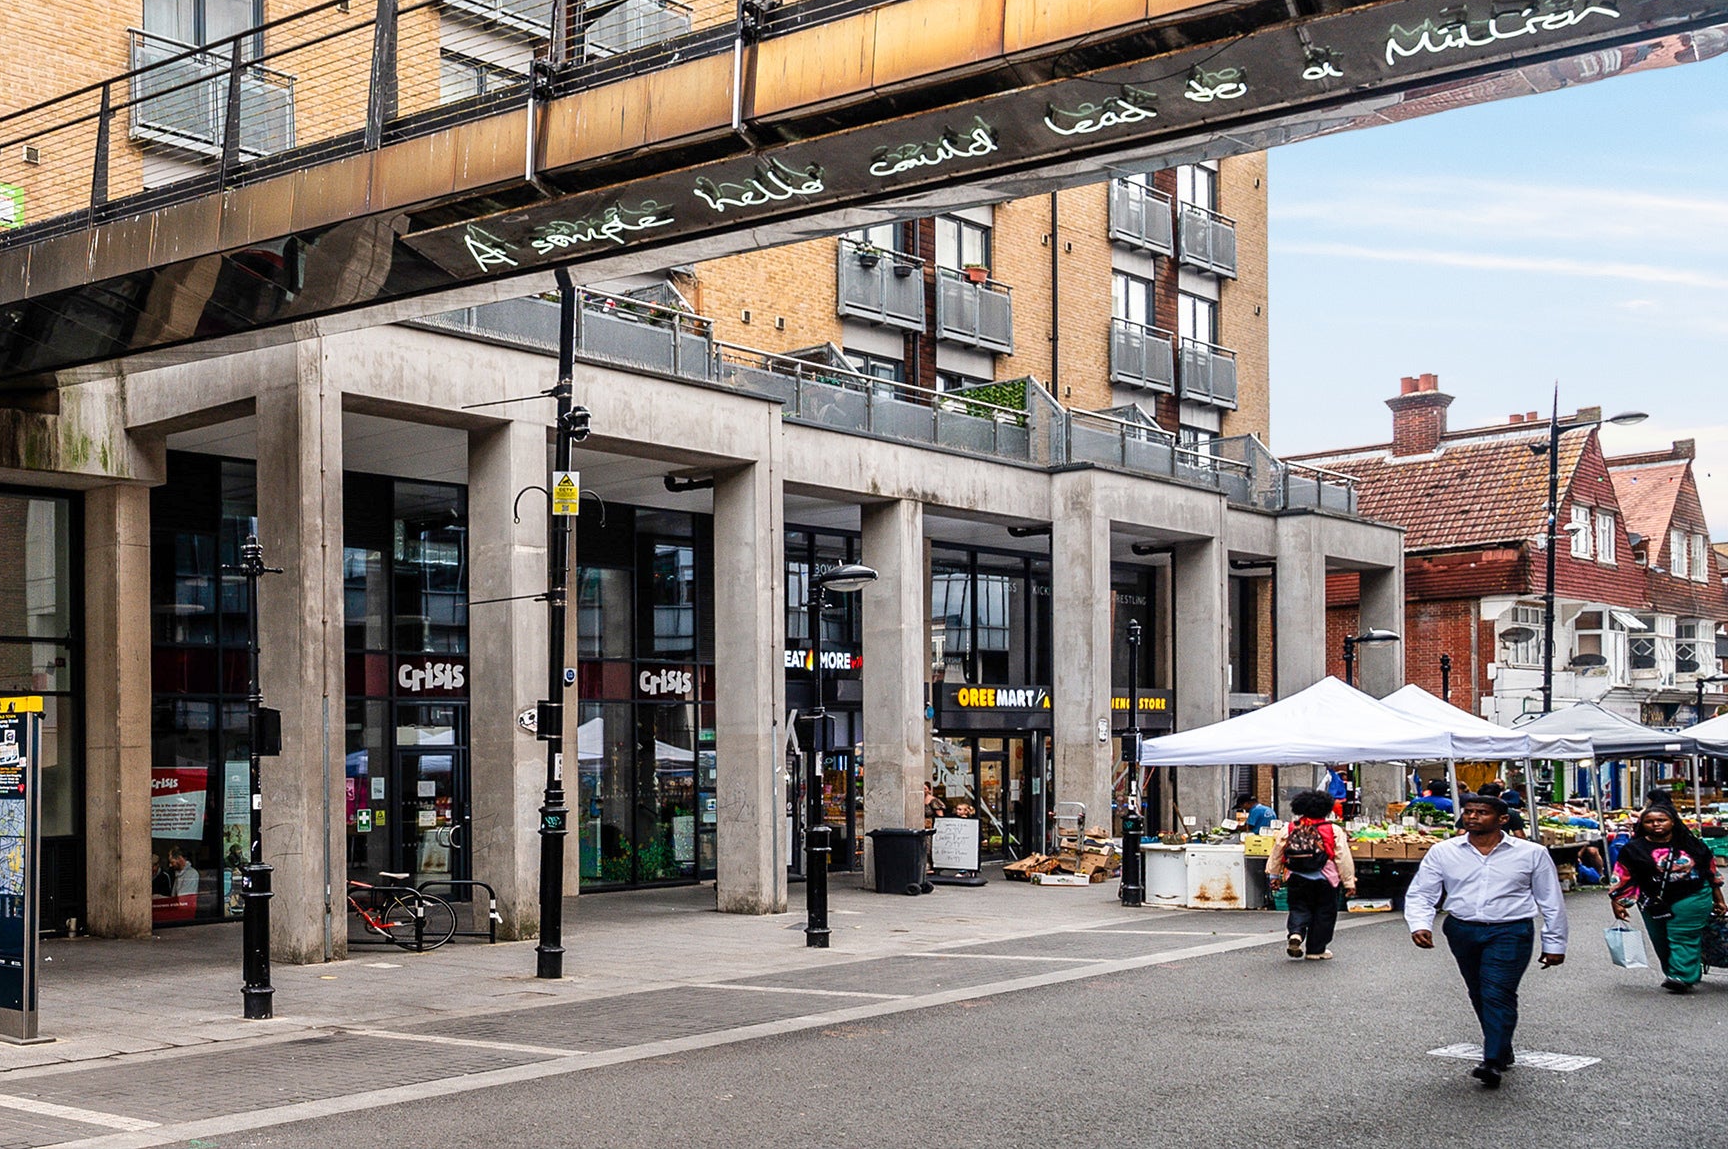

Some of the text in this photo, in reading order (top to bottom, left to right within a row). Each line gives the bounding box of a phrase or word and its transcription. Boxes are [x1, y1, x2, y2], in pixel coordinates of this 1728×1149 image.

[465, 234, 519, 272] A
[694, 171, 824, 212] hello
[869, 127, 998, 176] could
[1302, 62, 1344, 80] a
[1116, 593, 1147, 605] RESTLING
[784, 650, 807, 668] EAT
[820, 652, 851, 670] MORE
[1138, 697, 1166, 710] STORE
